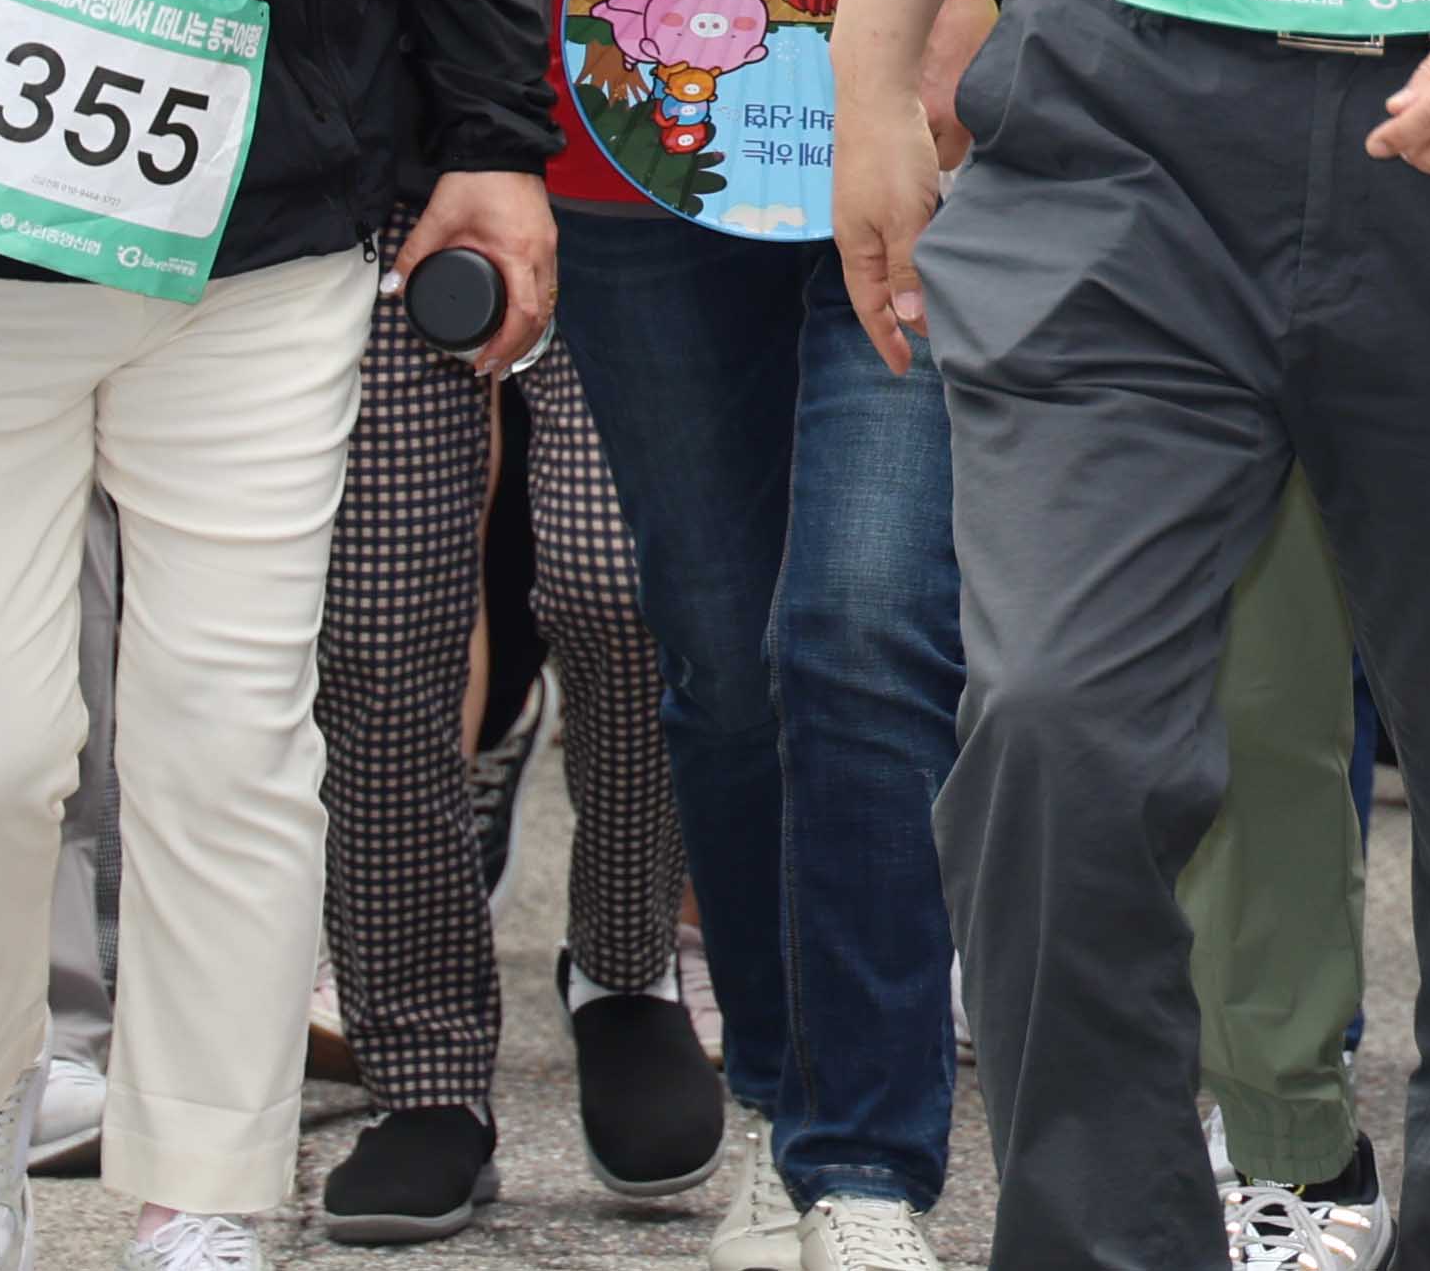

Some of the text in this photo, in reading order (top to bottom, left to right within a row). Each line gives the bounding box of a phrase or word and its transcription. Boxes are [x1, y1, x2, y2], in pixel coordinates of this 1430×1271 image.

[150, 4, 210, 49] 떠나는
[206, 16, 263, 59] 동구여행
[744, 103, 794, 129] 신협
[741, 139, 793, 165] 하는
